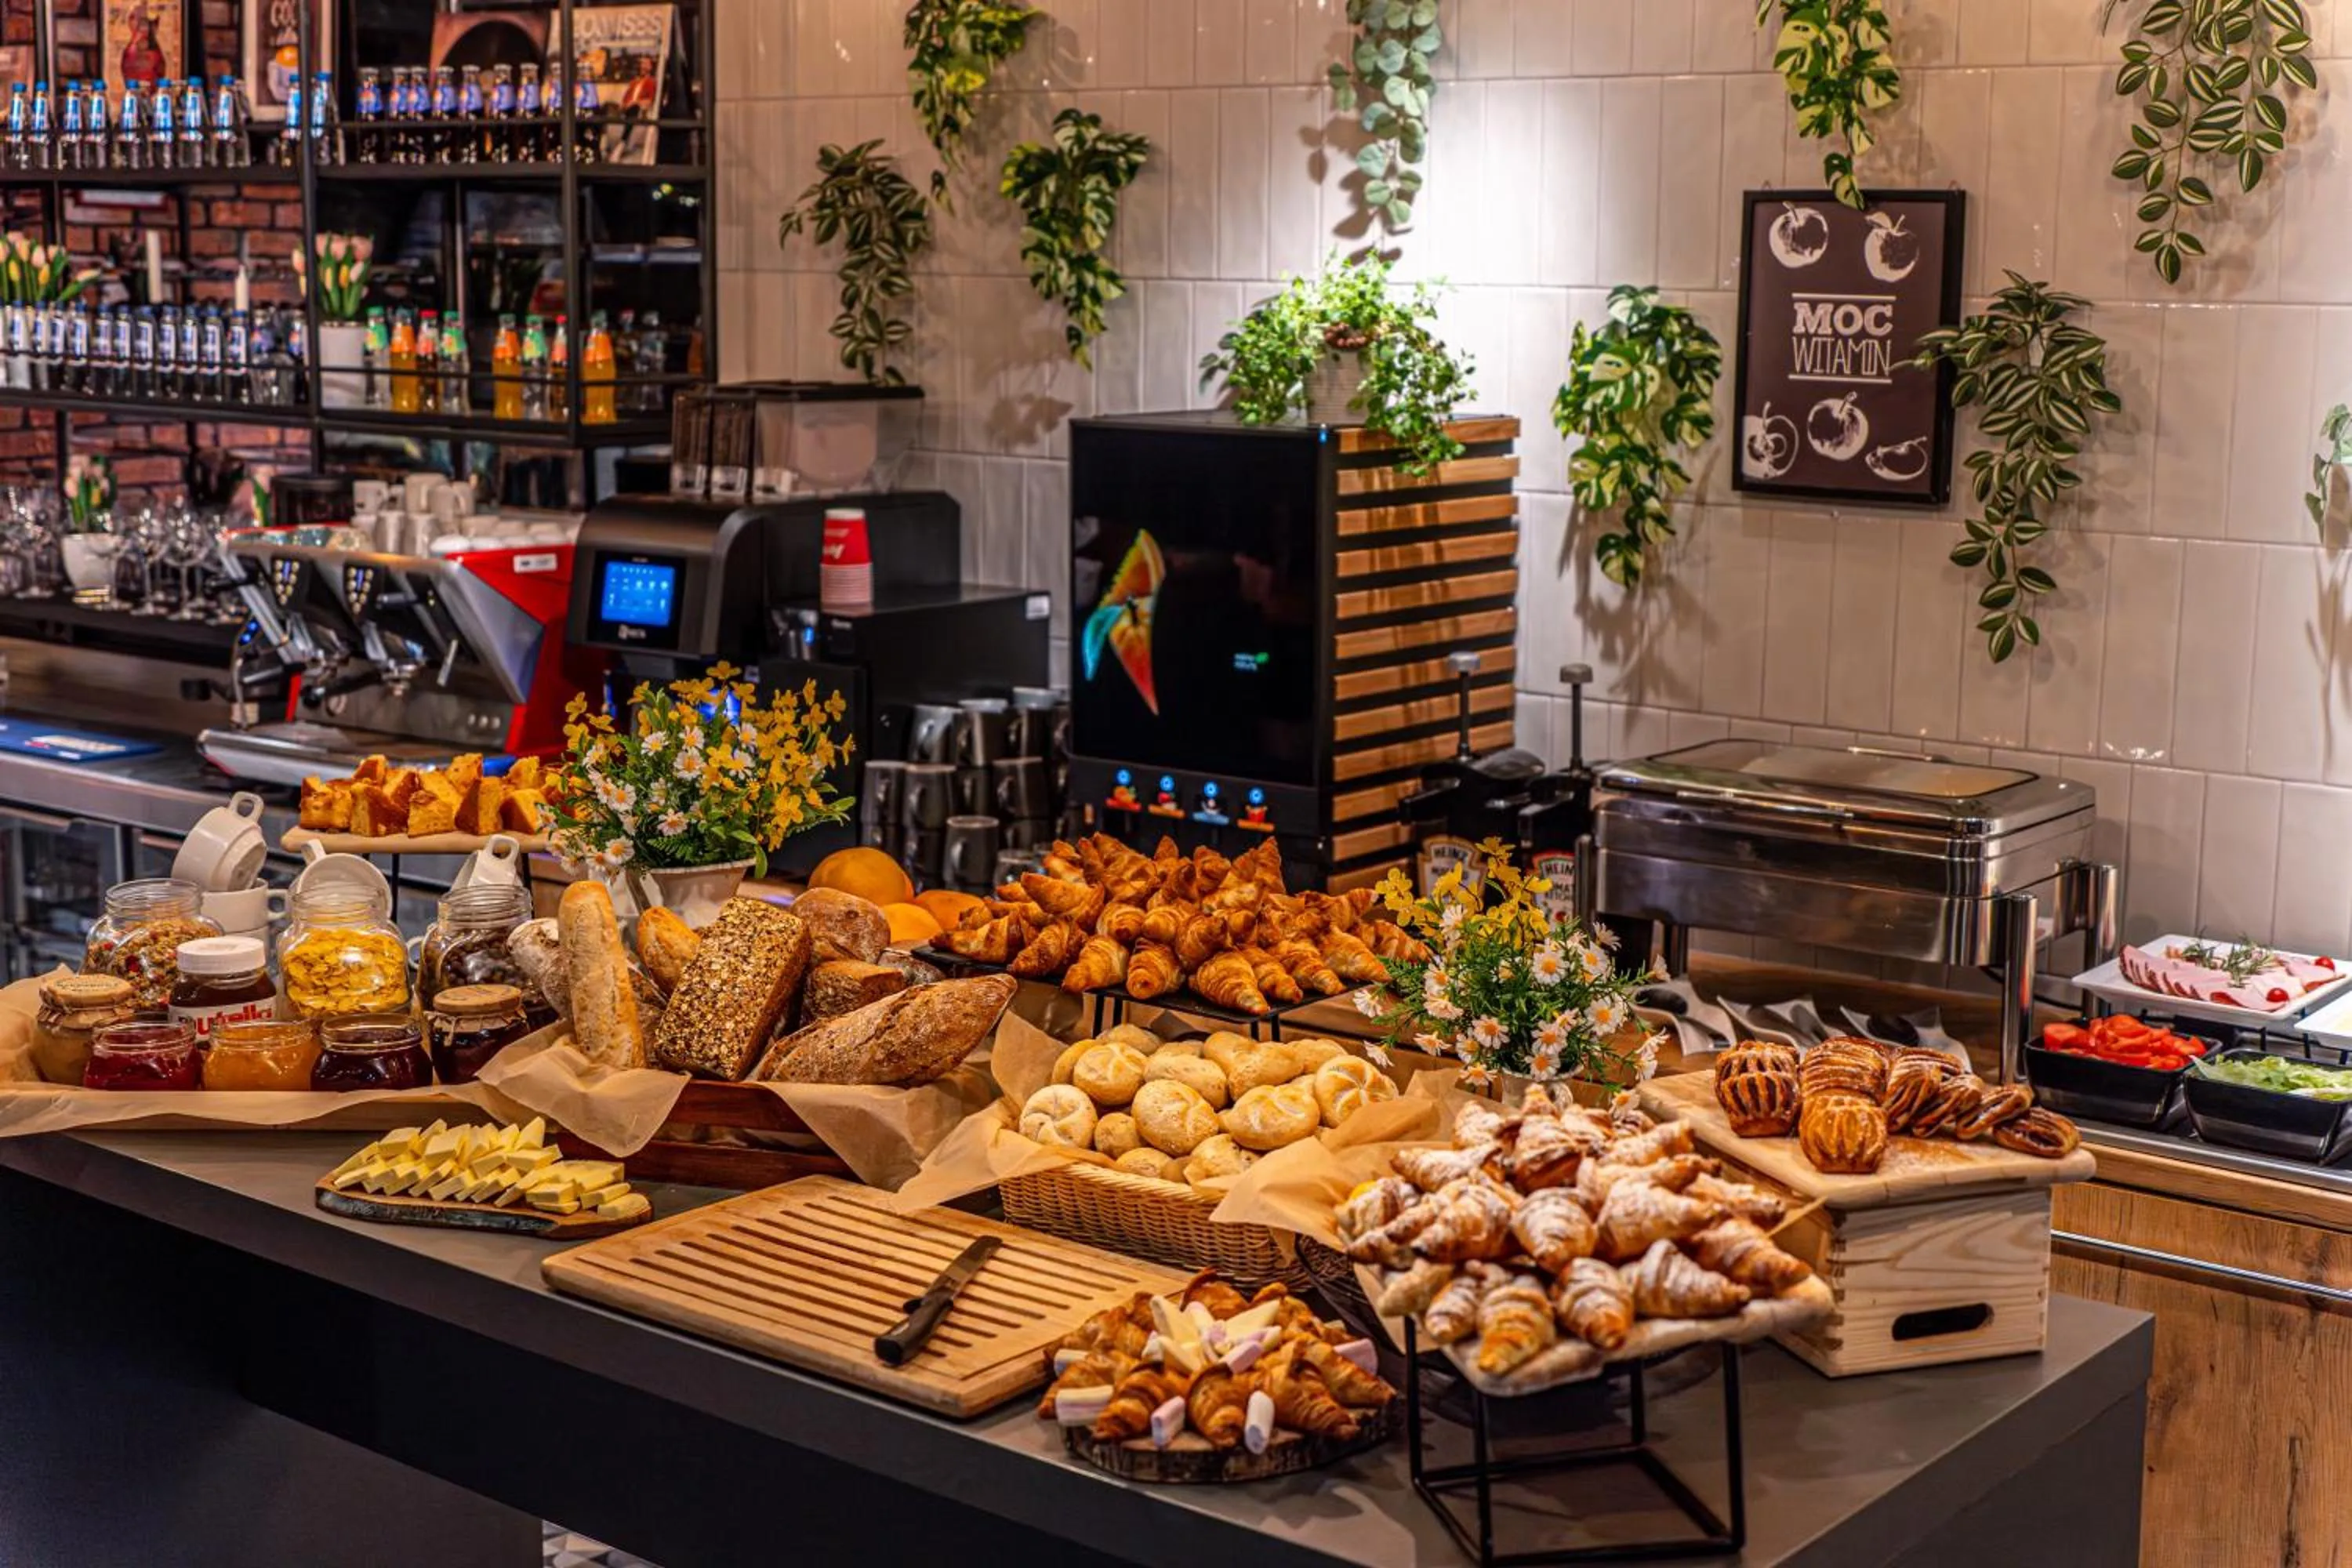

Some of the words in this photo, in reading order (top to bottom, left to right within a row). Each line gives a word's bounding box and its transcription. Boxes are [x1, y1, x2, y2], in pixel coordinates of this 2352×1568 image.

[1792, 302, 1893, 336] MOC
[1792, 336, 1892, 376] WITAMIN
[1545, 862, 1575, 877] HEIN
